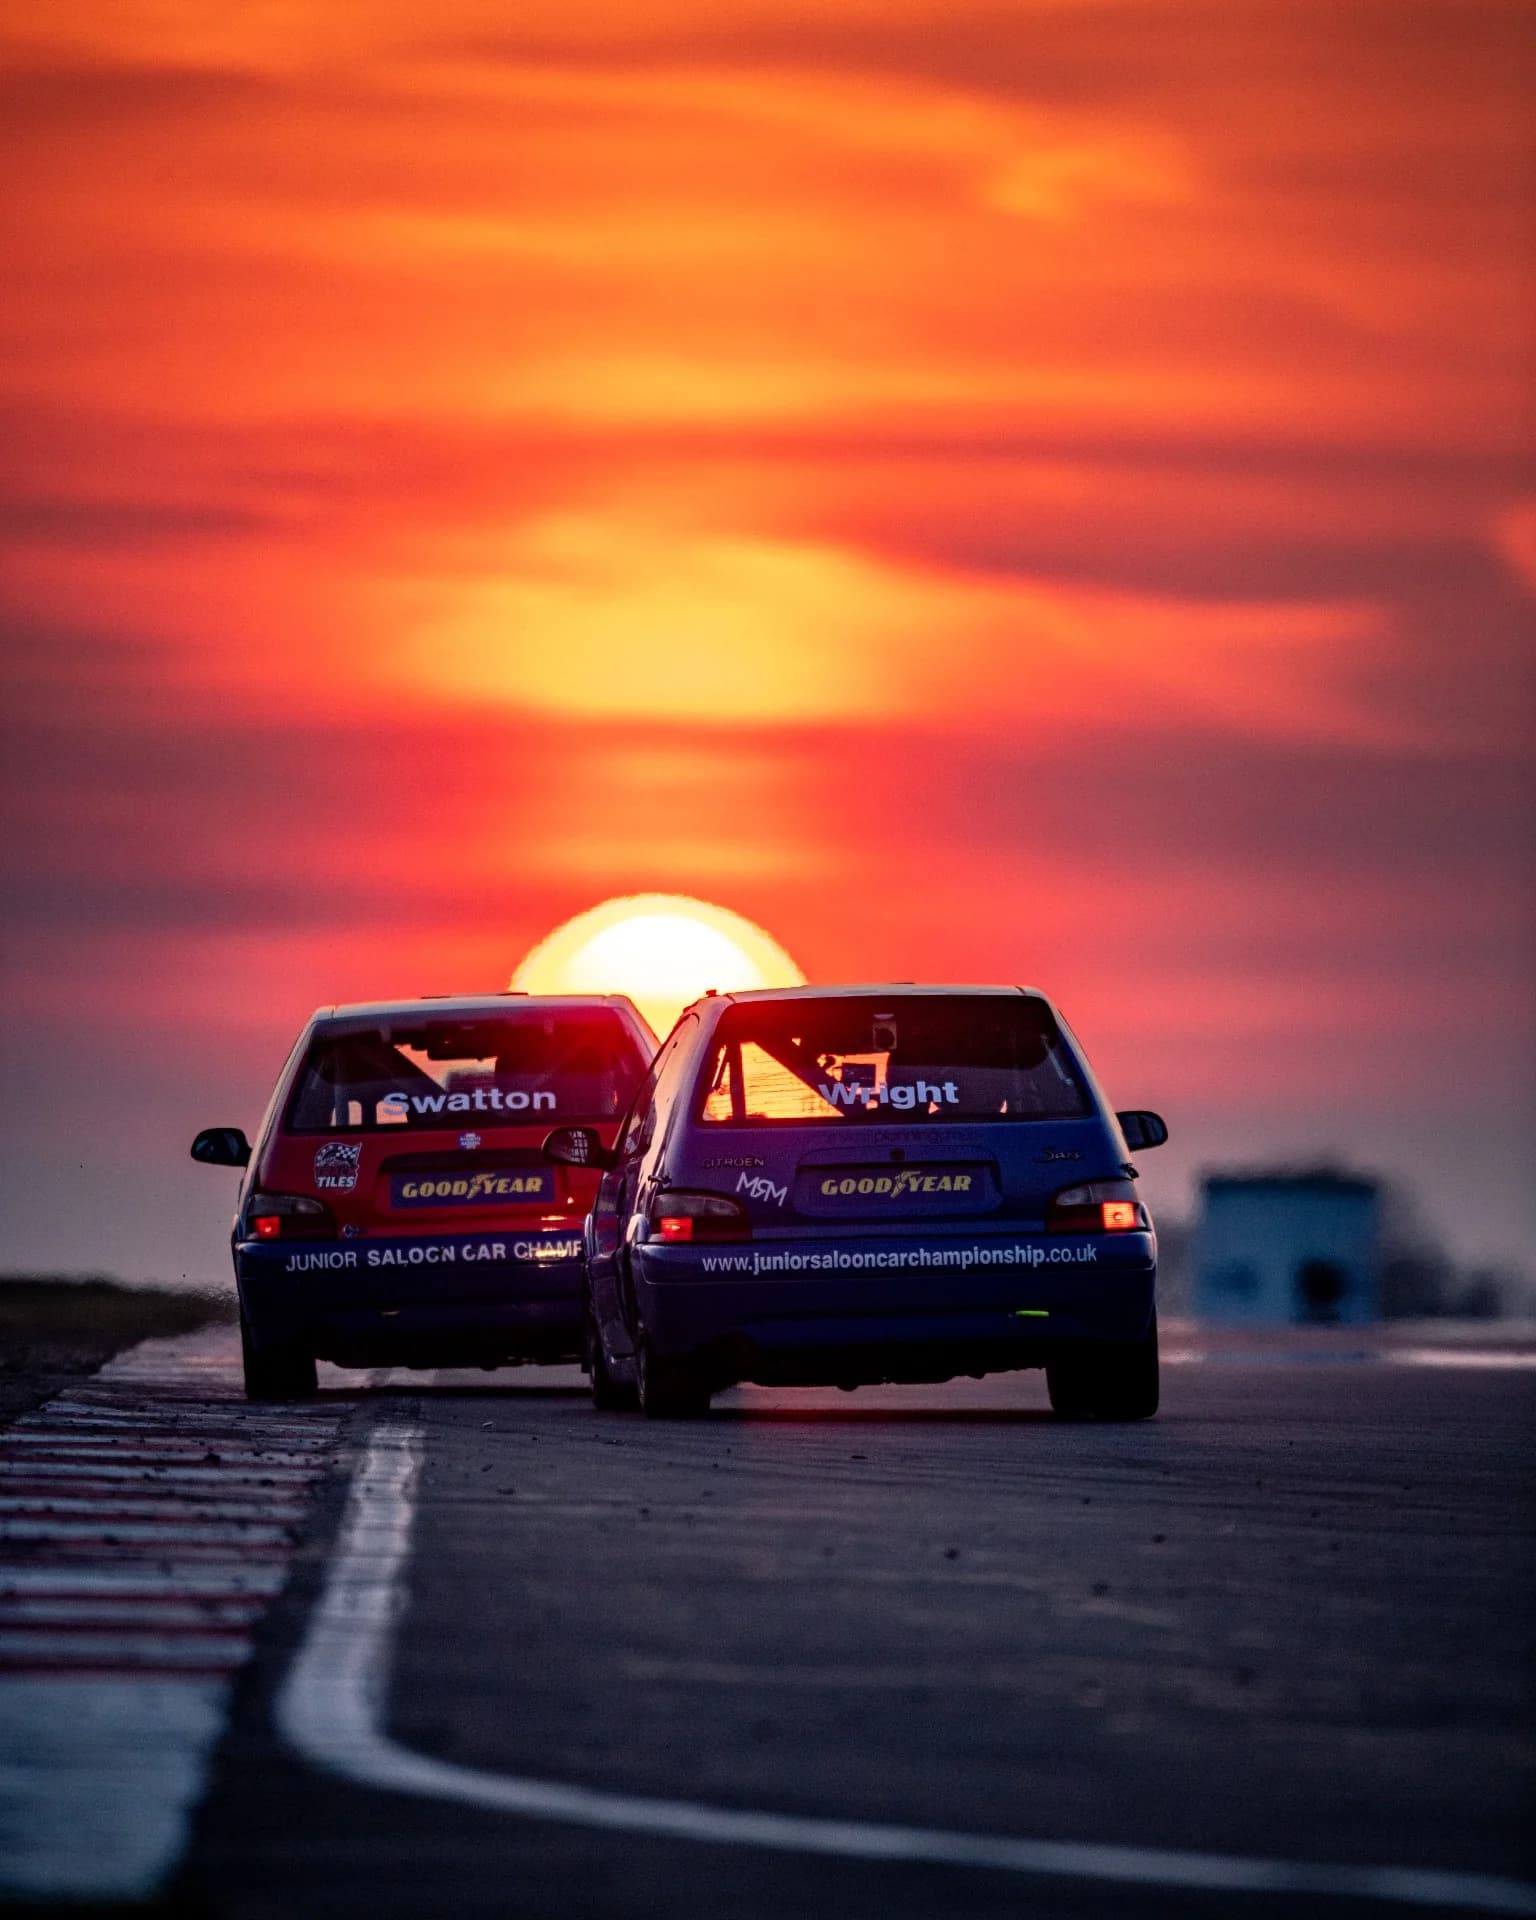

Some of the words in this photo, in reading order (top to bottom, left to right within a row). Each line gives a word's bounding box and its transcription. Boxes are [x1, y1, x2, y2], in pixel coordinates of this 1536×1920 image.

[383, 1088, 557, 1116] Swatton
[818, 1081, 958, 1110] Wright
[317, 1176, 355, 1188] TILES
[402, 1174, 543, 1199] GOODYEAR
[820, 1171, 971, 1199] GOODYEAR
[286, 1252, 357, 1272] JUNIOR
[462, 1243, 506, 1261] CAR
[702, 1244, 1097, 1275] www.juniorsalooncarchampionship.co.uk
